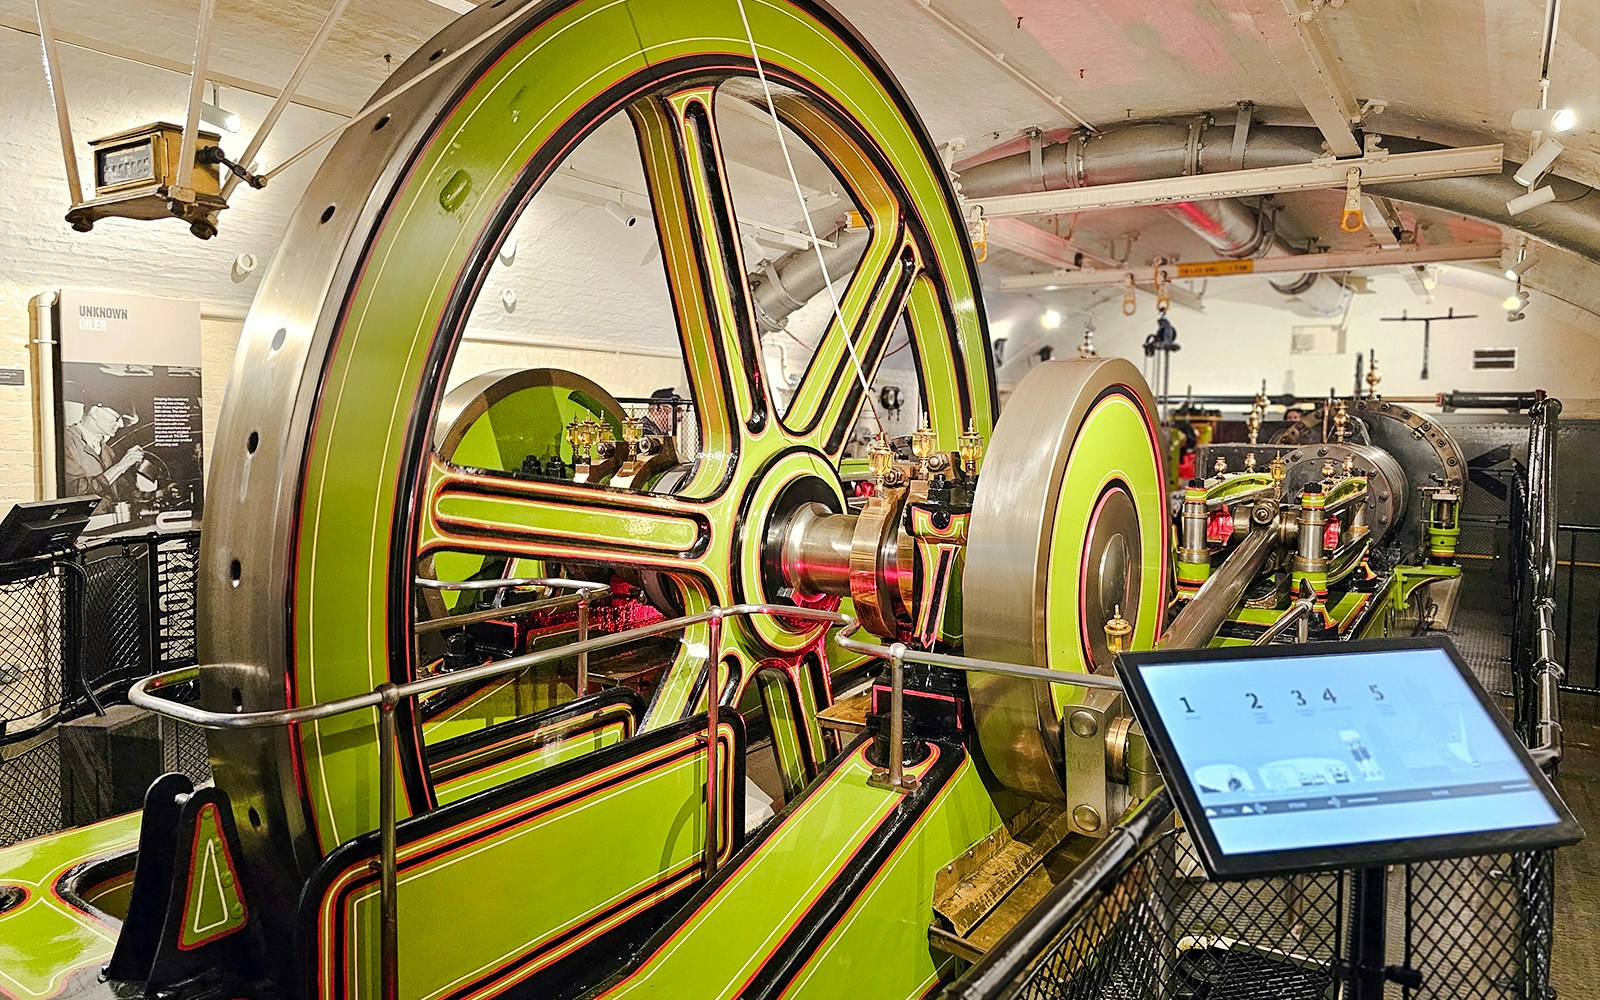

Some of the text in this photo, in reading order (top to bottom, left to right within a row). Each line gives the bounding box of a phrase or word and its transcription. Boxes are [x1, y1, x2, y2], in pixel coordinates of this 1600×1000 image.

[79, 305, 128, 320] UNKNOWN
[79, 318, 107, 332] OILER
[1180, 684, 1384, 713] 1 2 3 4 5
